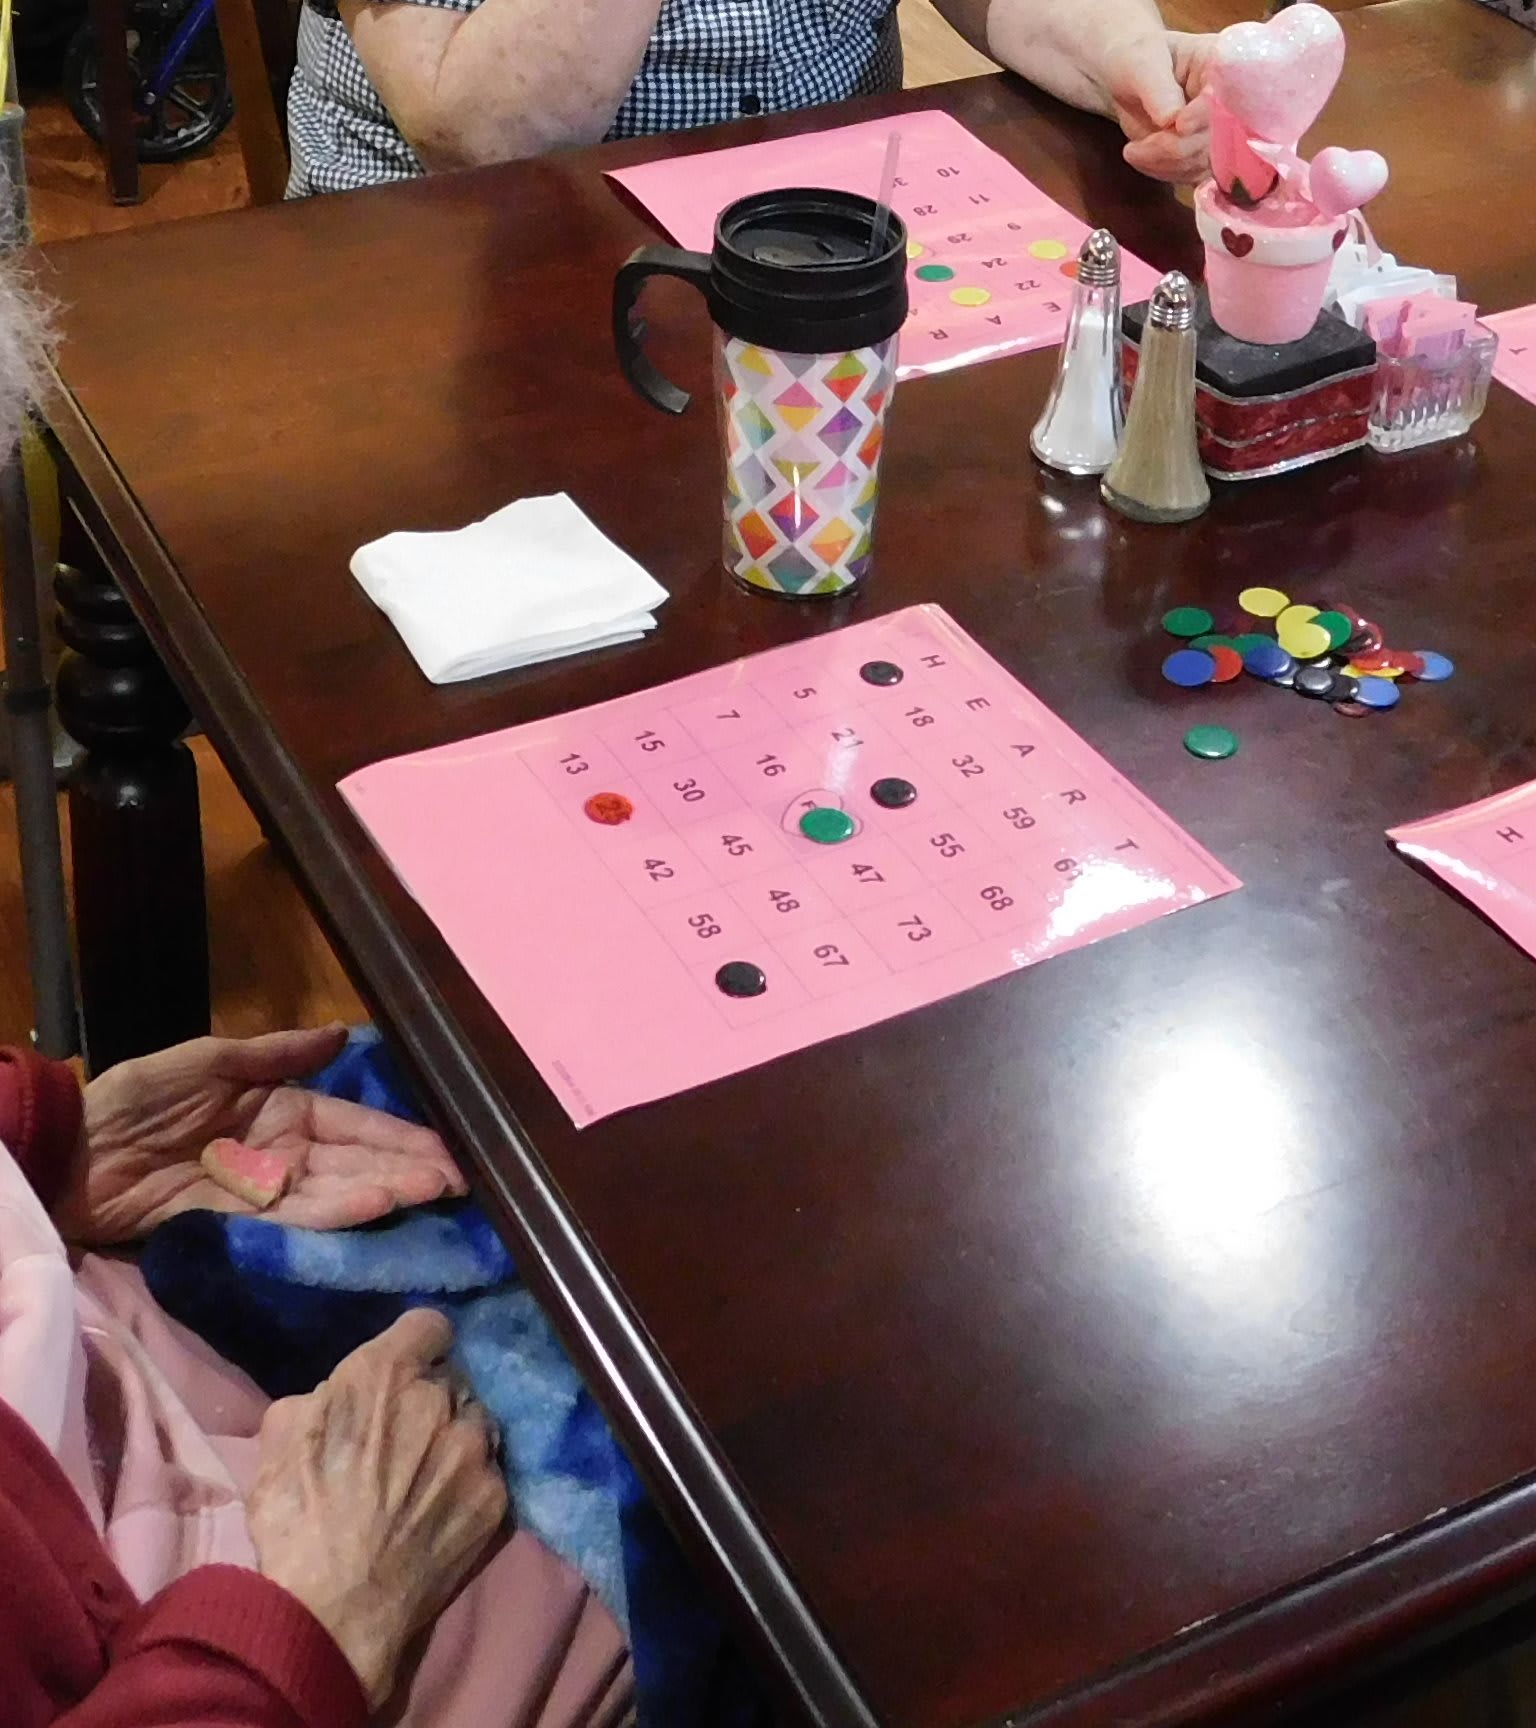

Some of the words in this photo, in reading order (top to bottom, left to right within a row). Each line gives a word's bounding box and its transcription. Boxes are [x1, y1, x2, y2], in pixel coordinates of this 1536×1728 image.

[559, 753, 589, 775] 13
[644, 858, 675, 882] 42
[687, 913, 722, 939] 58
[634, 730, 666, 752] 15
[673, 778, 706, 802] 30
[721, 834, 754, 857] 45
[769, 889, 801, 913] 48
[813, 944, 850, 967] 67
[716, 709, 741, 720] 7
[756, 754, 786, 777] 16
[851, 863, 885, 883] 47
[897, 914, 932, 942] 73
[793, 687, 817, 700] 5
[930, 832, 966, 858] 55
[979, 885, 1014, 911] 68
[904, 706, 935, 728] 18
[951, 754, 985, 779] 32
[1002, 806, 1036, 830] 59
[919, 654, 947, 669] H
[965, 696, 991, 712] E
[1010, 744, 1036, 758] A
[1059, 788, 1087, 806] R
[1114, 838, 1140, 851] T
[1496, 826, 1524, 844] H
